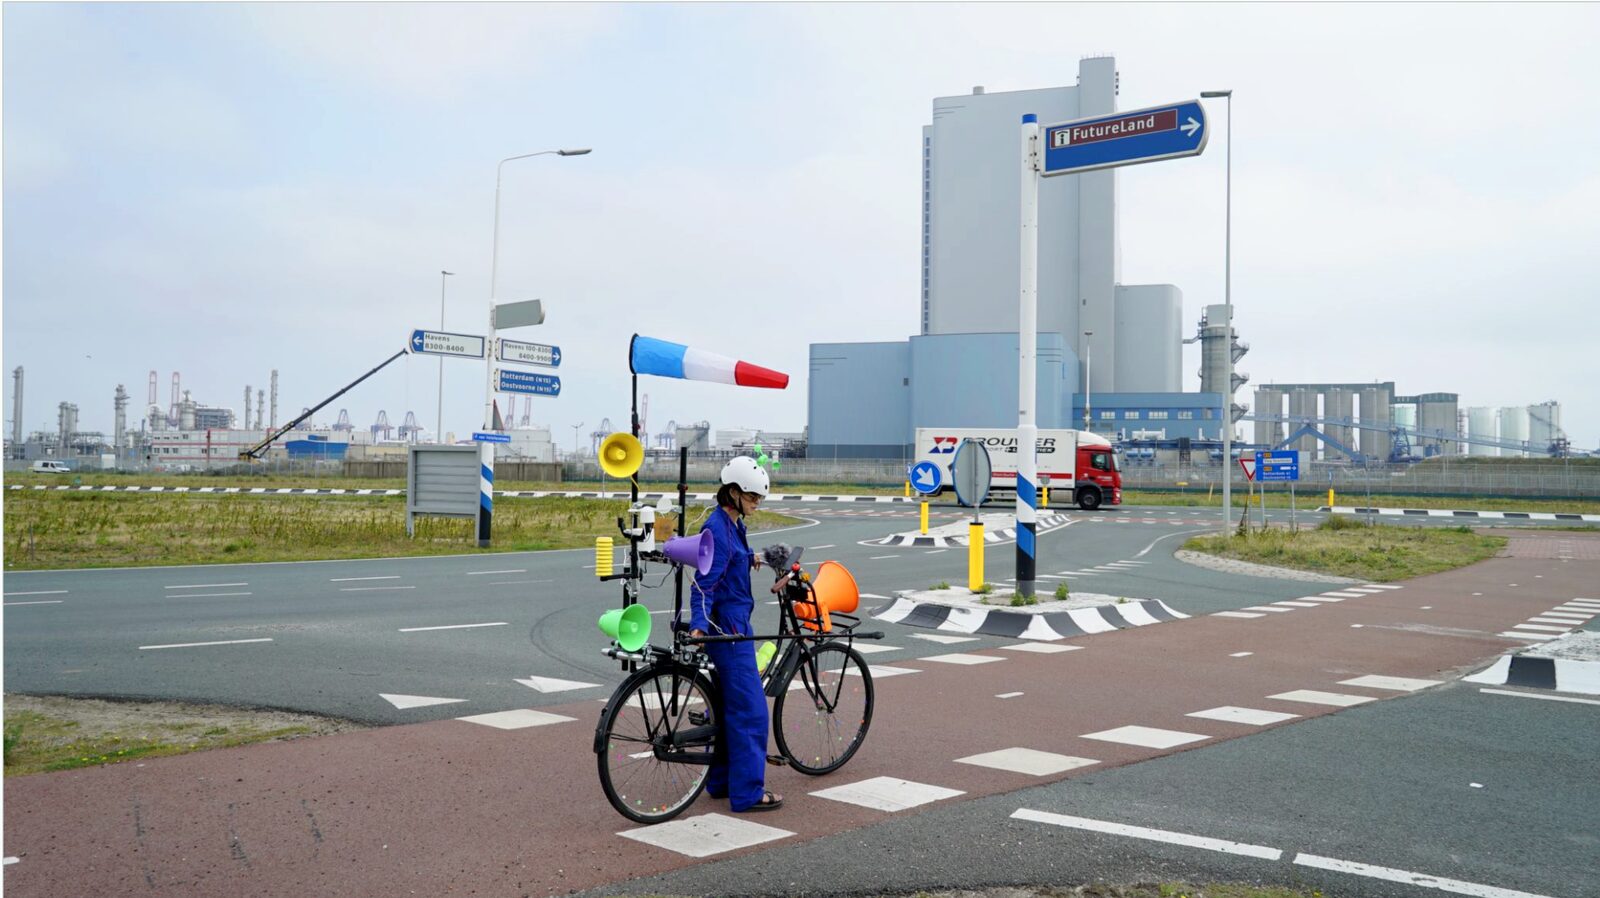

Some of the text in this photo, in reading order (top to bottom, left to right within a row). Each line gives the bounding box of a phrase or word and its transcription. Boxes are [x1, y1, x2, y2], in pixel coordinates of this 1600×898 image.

[1073, 115, 1155, 140] FutureLand
[425, 333, 450, 342] Havens
[425, 343, 464, 352] 8300-8400
[502, 372, 534, 382] Rotterdam
[502, 381, 536, 390] Oostvoorne
